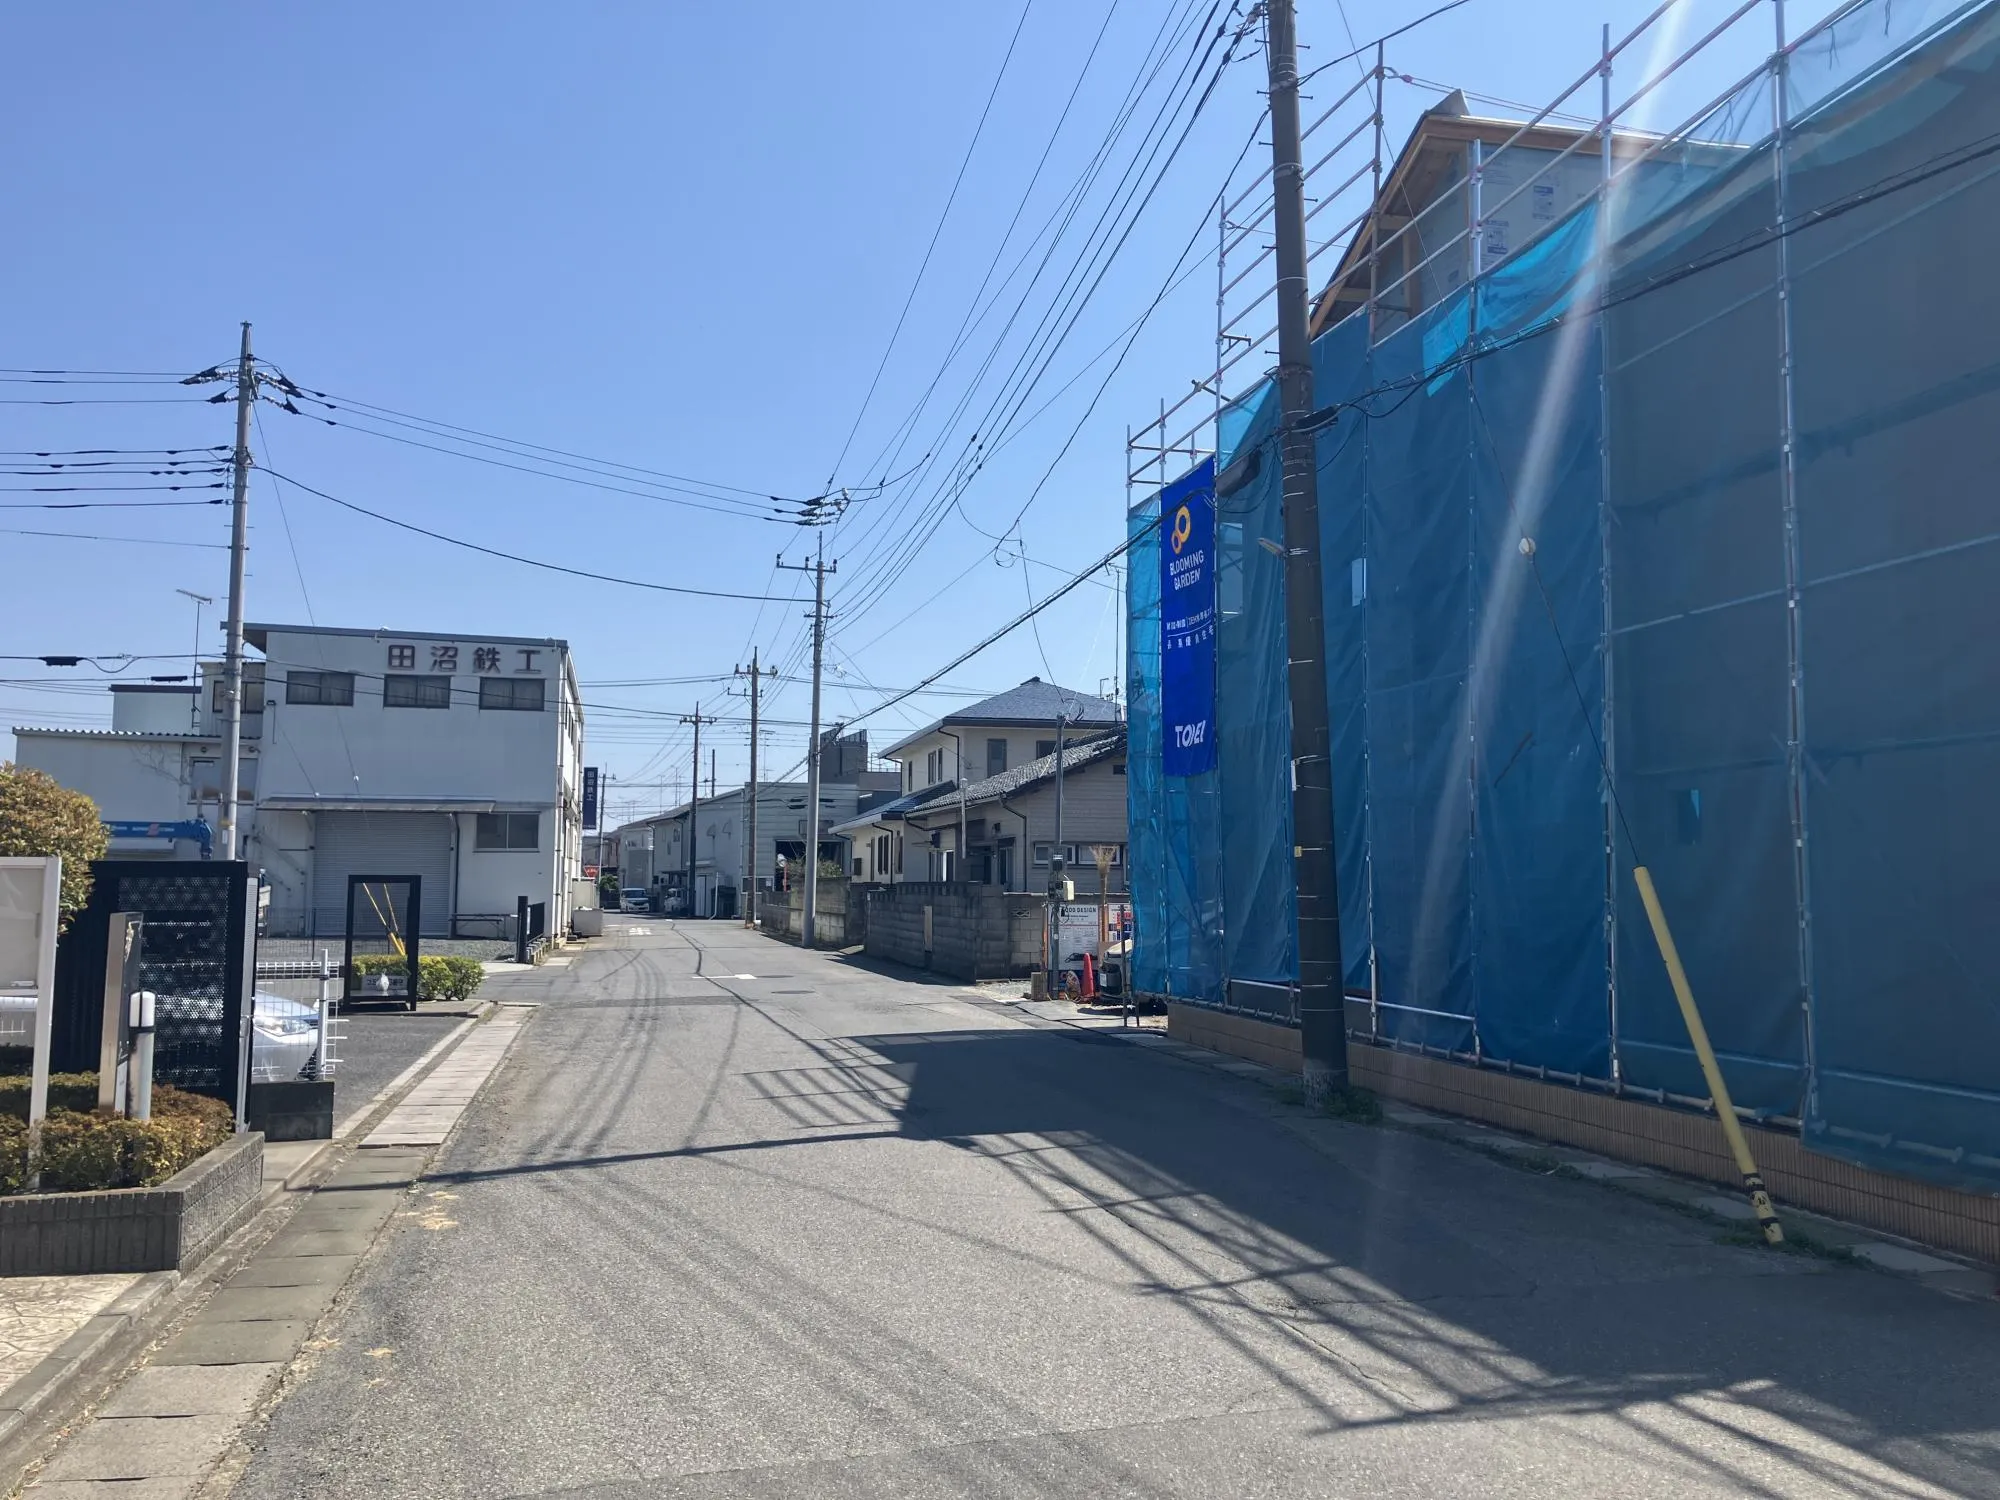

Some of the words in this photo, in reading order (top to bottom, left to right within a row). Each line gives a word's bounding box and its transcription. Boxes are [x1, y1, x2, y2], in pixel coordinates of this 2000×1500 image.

[1169, 549, 1205, 577] BLOOMING
[1173, 567, 1201, 591] GARDEN
[388, 644, 542, 674] 田沼鉄工
